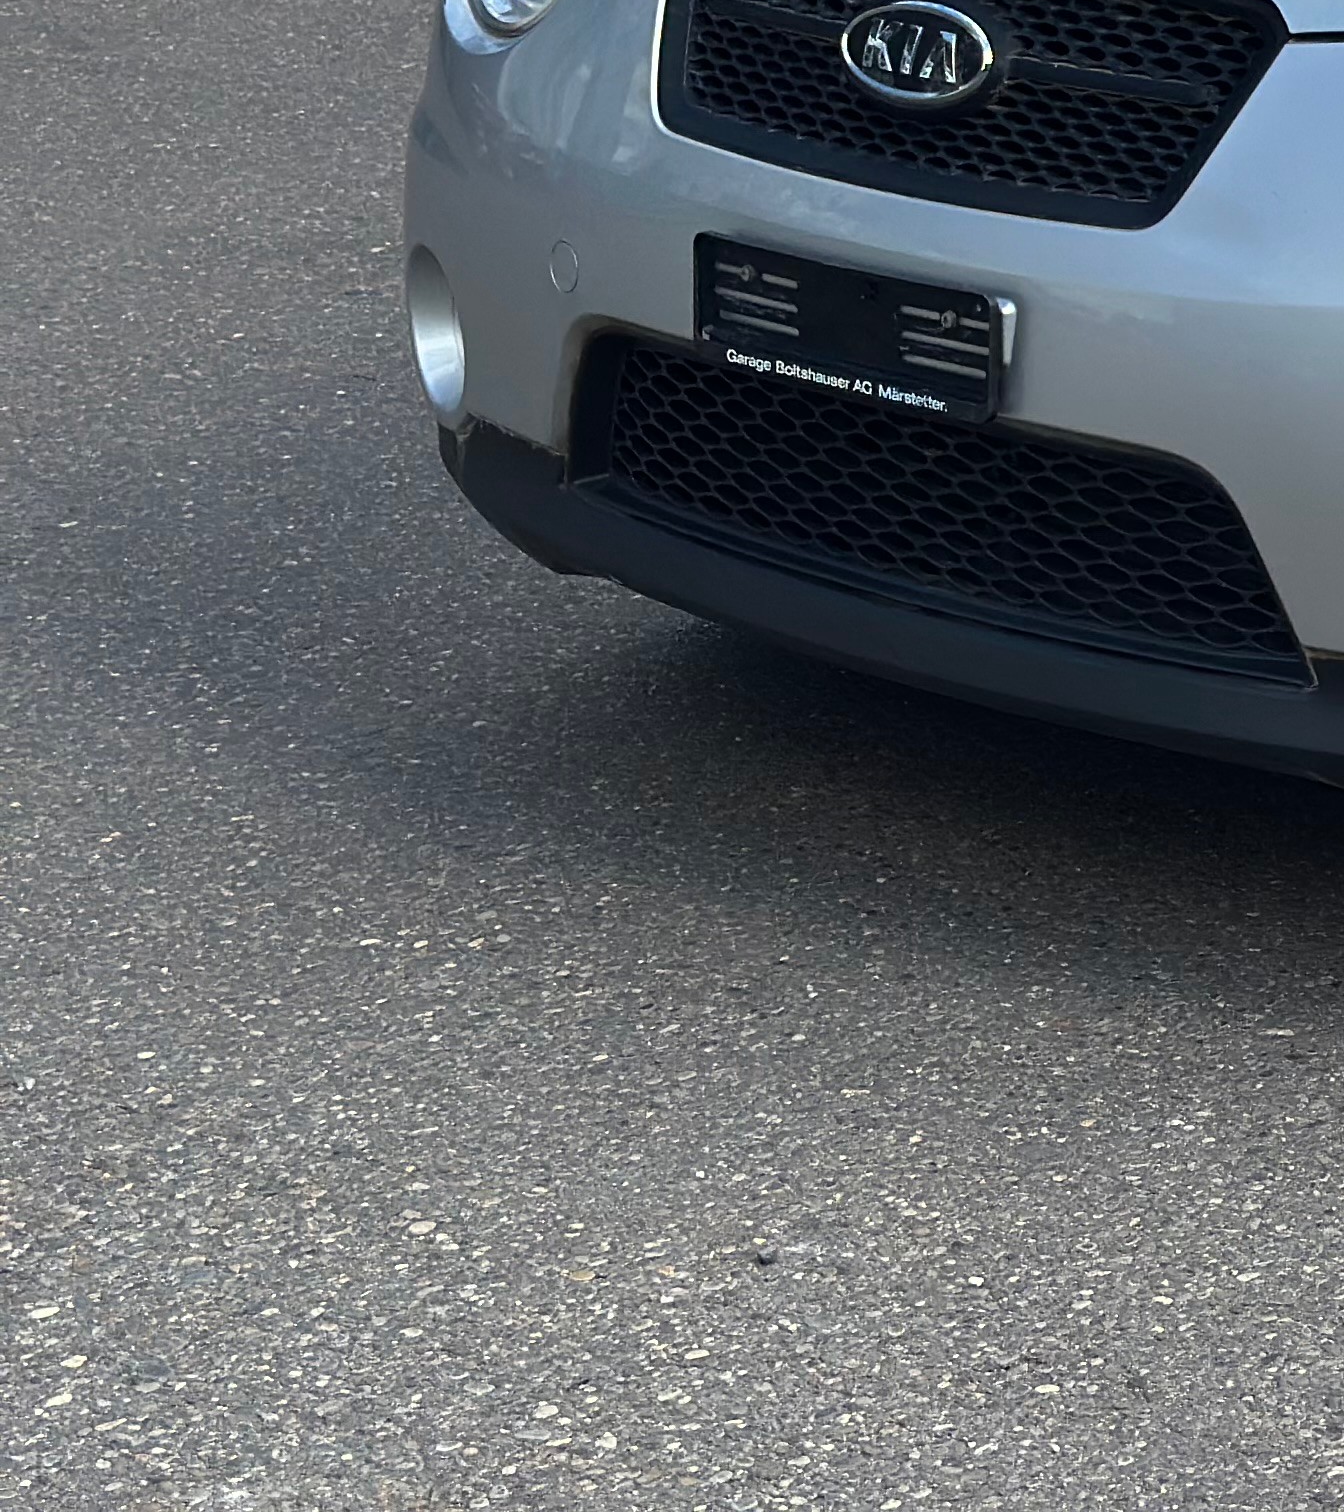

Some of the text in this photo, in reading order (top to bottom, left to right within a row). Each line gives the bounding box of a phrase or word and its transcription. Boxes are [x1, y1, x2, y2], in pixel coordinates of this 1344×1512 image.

[862, 18, 957, 83] KIA
[726, 348, 772, 372] Garage
[852, 378, 872, 395] AG
